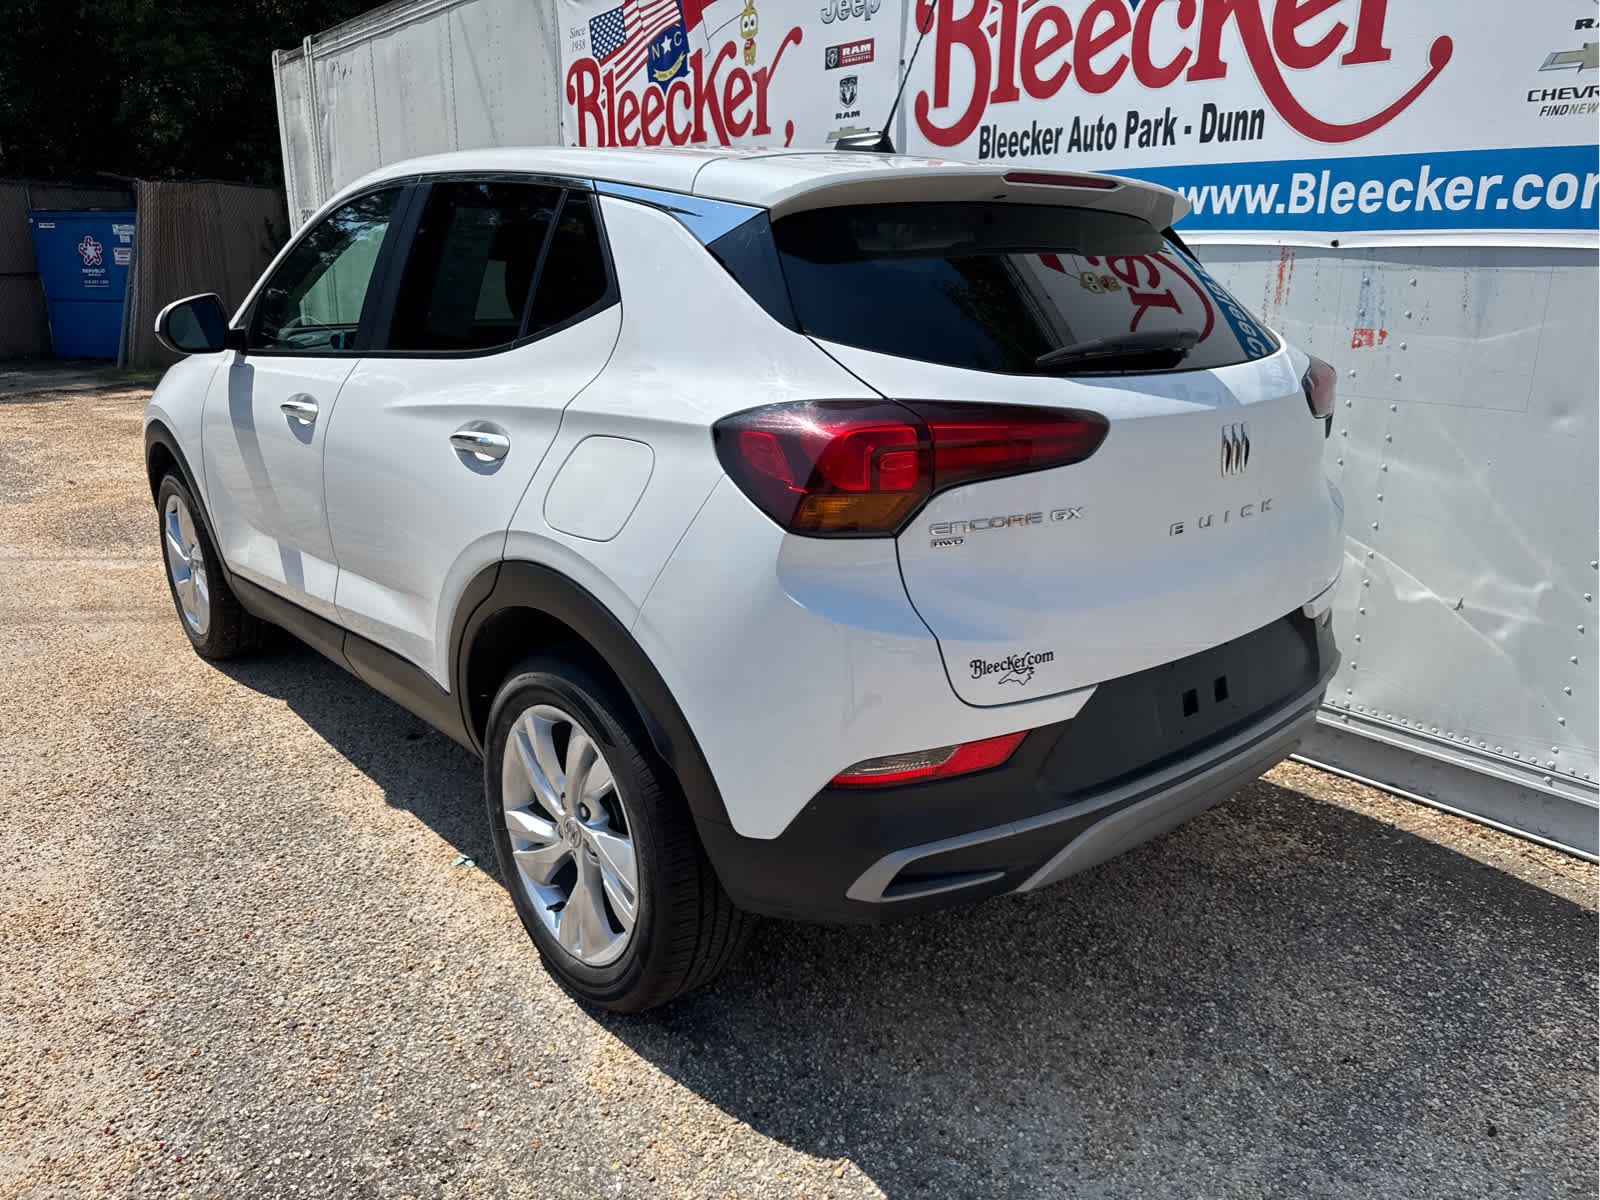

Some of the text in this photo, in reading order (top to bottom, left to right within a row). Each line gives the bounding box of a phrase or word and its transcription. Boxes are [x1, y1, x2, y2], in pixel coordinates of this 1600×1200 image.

[842, 43, 873, 56] RAM
[835, 110, 861, 120] RAM
[978, 119, 1064, 160] Bleecker
[1067, 114, 1117, 153] Auto
[1124, 107, 1178, 149] Park
[1199, 102, 1266, 144] Dunn
[929, 506, 1083, 536] ENCORE GX
[1169, 498, 1273, 537] BUICK
[932, 537, 965, 549] AWD
